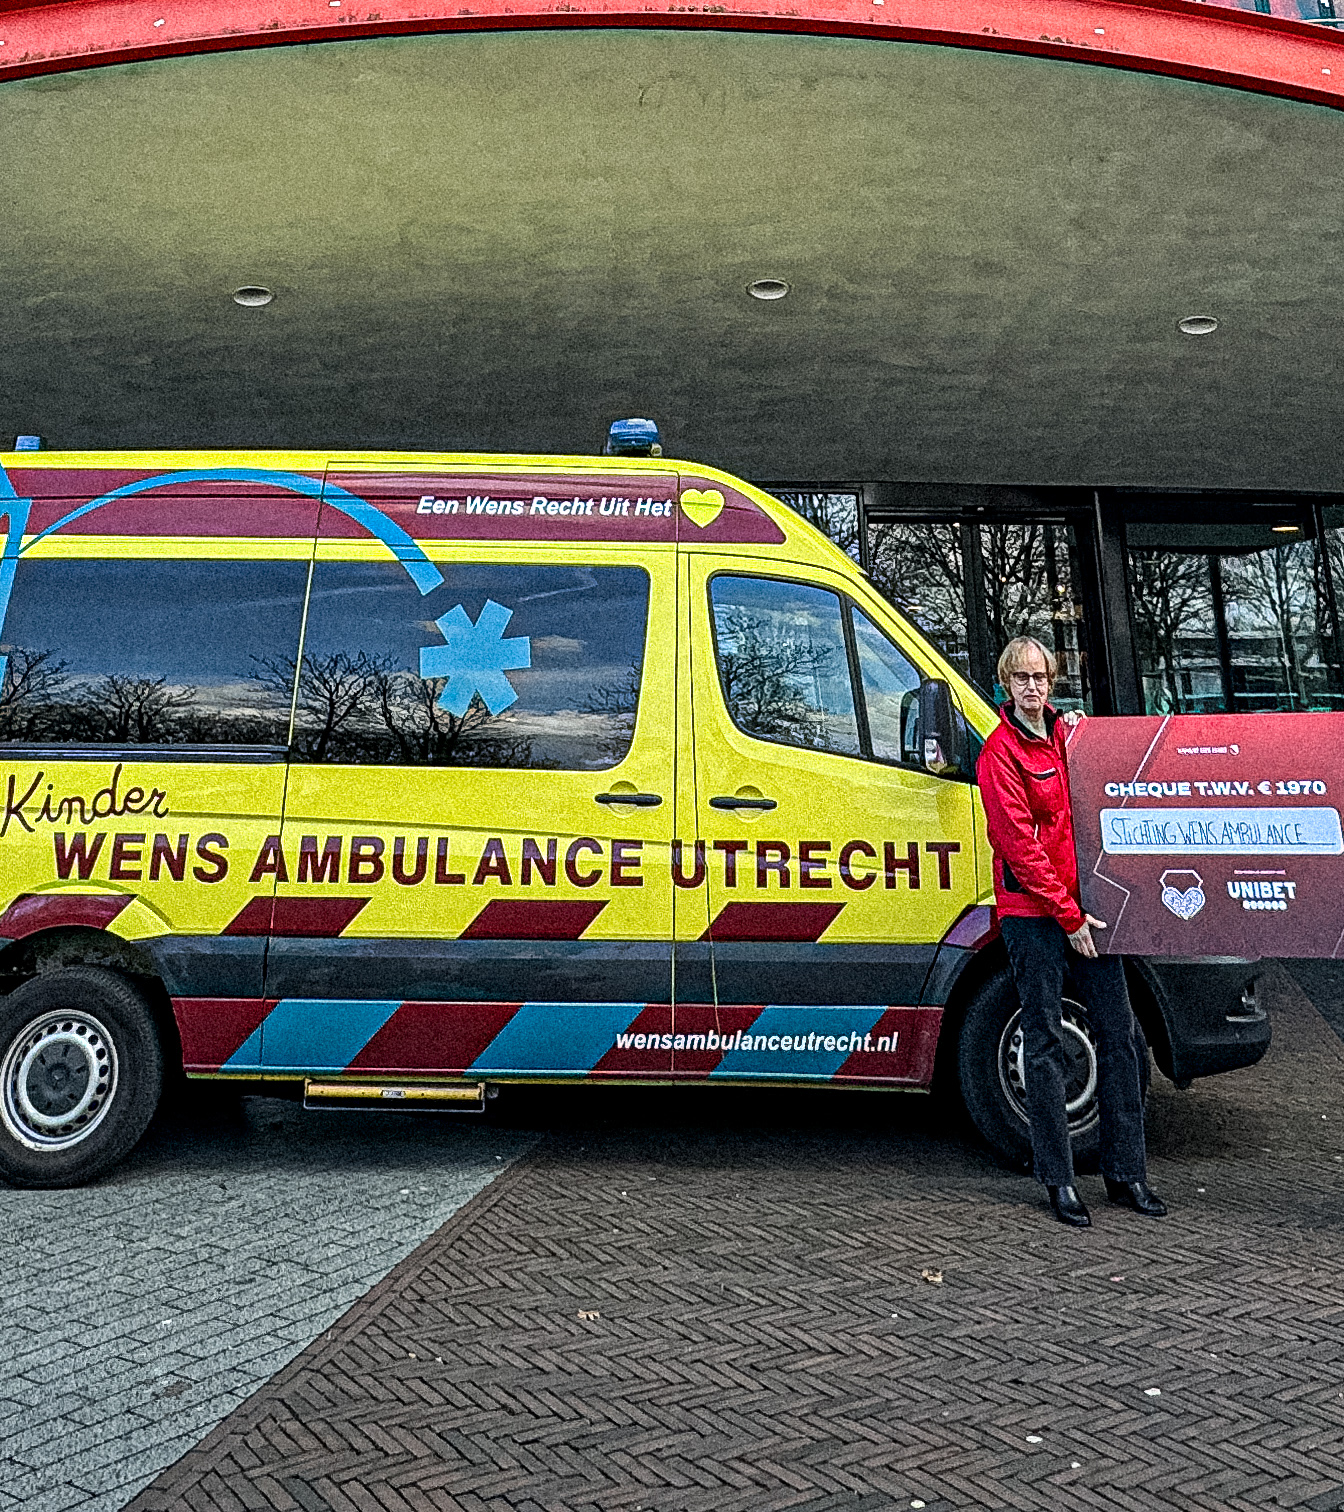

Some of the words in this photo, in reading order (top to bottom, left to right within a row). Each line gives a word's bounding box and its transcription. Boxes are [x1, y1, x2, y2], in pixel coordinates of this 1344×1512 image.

[416, 495, 459, 515] Een
[465, 496, 525, 516] Wens
[529, 497, 594, 516] Recht
[599, 497, 630, 516] Uit
[634, 498, 673, 517] Het
[0, 763, 169, 837] Kinder
[1104, 781, 1192, 799] CHEQUE
[1194, 781, 1255, 796] T.W.V.
[1257, 781, 1272, 795] €
[1275, 780, 1327, 796] 1970
[53, 831, 230, 884] WENS
[248, 834, 645, 888] AMBULANCE
[671, 838, 961, 890] UTRECHT
[1227, 881, 1297, 900] UNIBET
[615, 1029, 899, 1052] wensambulanceutrecht.nl
